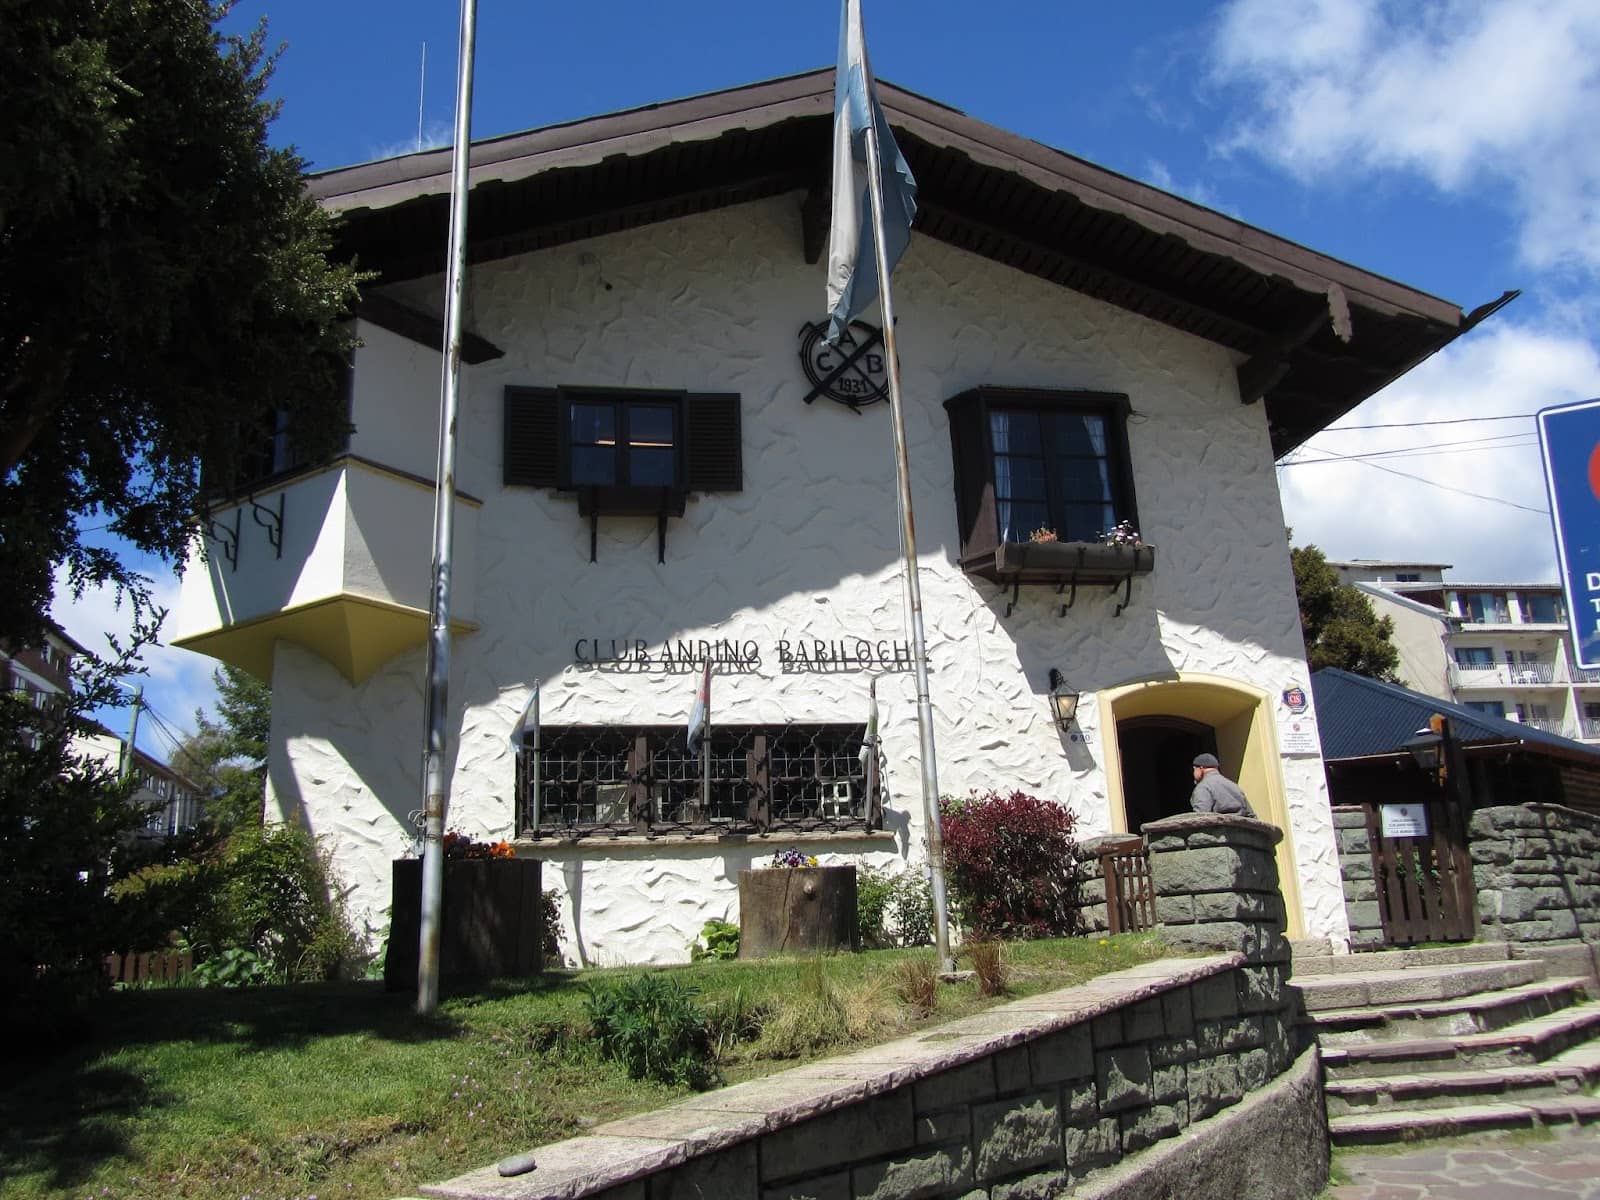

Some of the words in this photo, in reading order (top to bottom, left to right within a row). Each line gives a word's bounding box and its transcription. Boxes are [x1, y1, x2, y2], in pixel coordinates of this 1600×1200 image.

[575, 639, 648, 662] CLUB
[660, 639, 759, 662] ANDINO
[779, 639, 931, 663] BARILOCH
